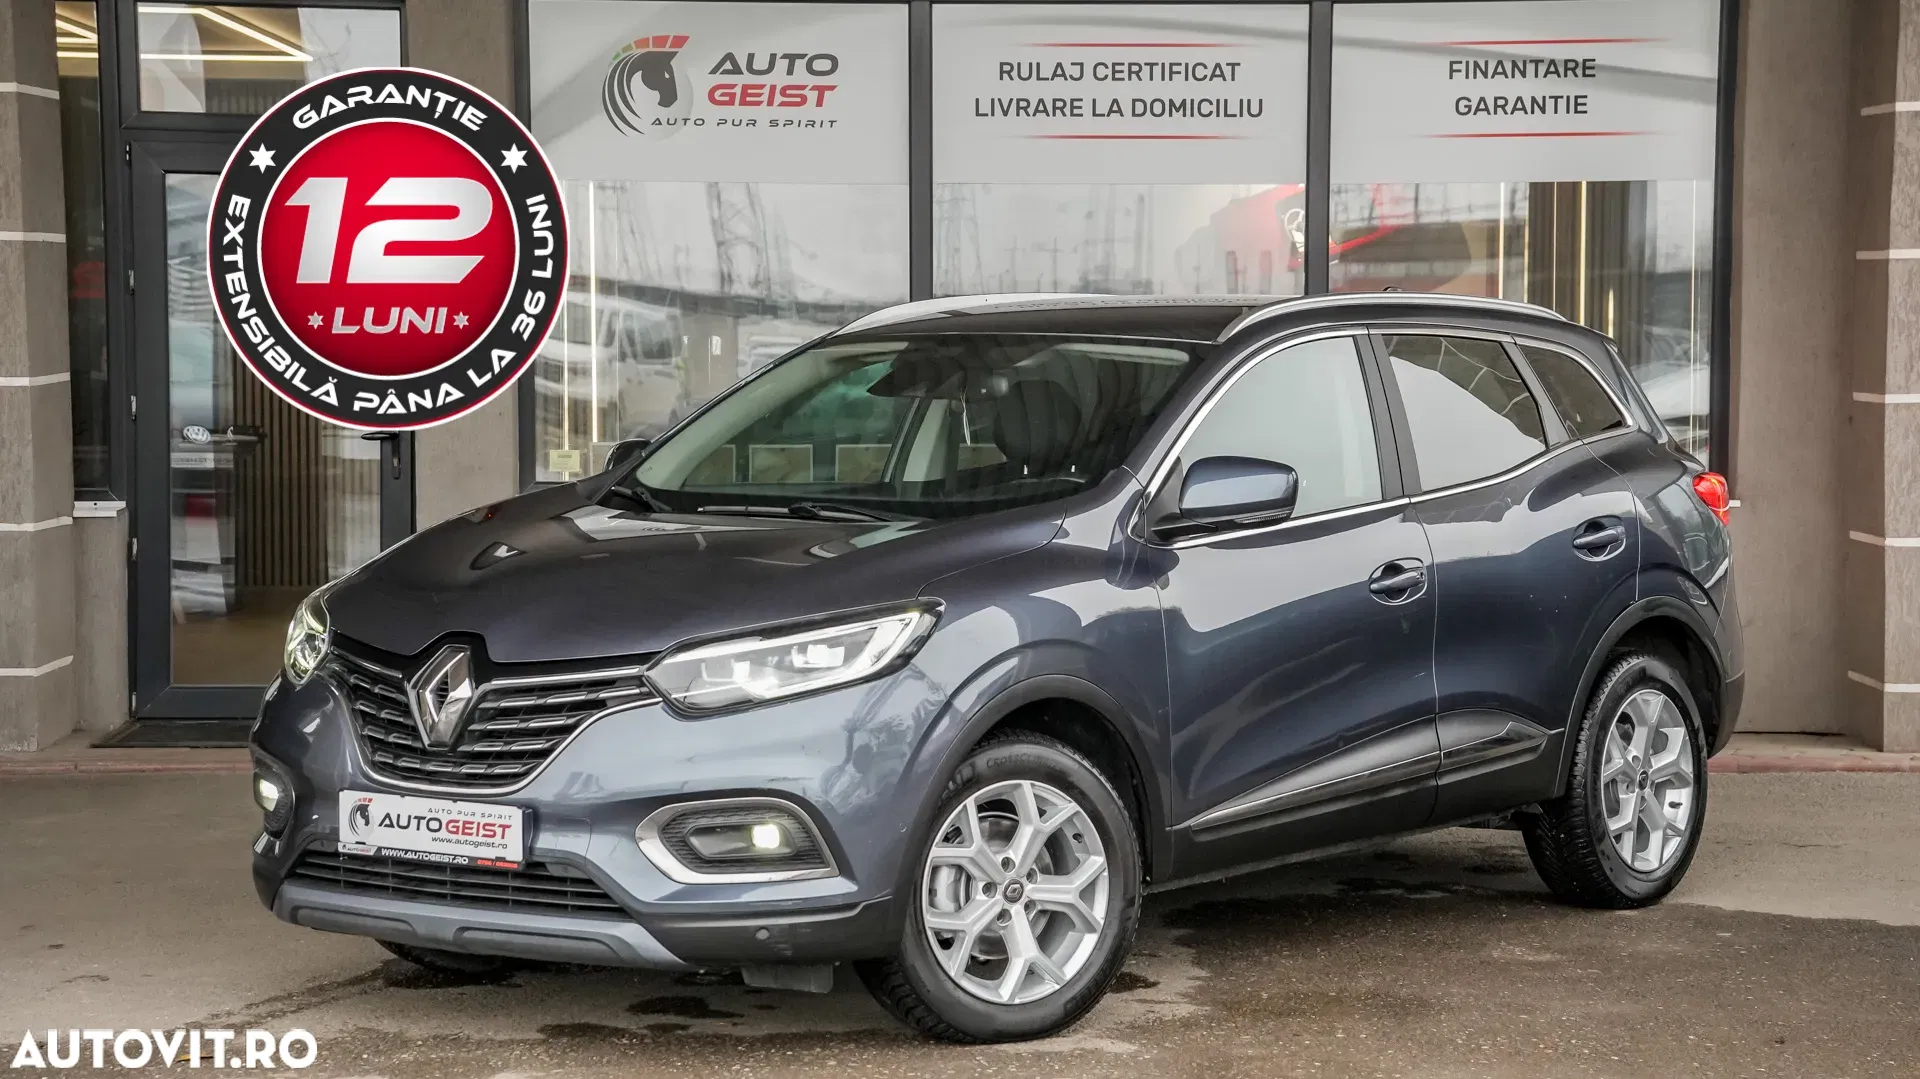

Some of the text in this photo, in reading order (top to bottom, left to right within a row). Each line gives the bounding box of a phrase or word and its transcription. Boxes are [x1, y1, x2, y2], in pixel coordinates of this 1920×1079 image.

[708, 52, 839, 77] AUTO
[999, 61, 1241, 82] RULAJ CERTIFICAT
[1448, 58, 1597, 80] FINANTARE
[707, 83, 839, 108] GEIST
[1454, 95, 1589, 116] GARANTIE
[974, 97, 1264, 118] LIVRARE LA DOMICILIU
[650, 117, 838, 129] AUTO PUR SPIRIT
[428, 807, 453, 815] AUTO
[481, 812, 513, 820] SPIRIT
[378, 812, 512, 840] AUTOGEIST
[431, 836, 508, 849] www.autogeist.ro
[381, 848, 469, 865] WWW.AUTOGEIST.RO
